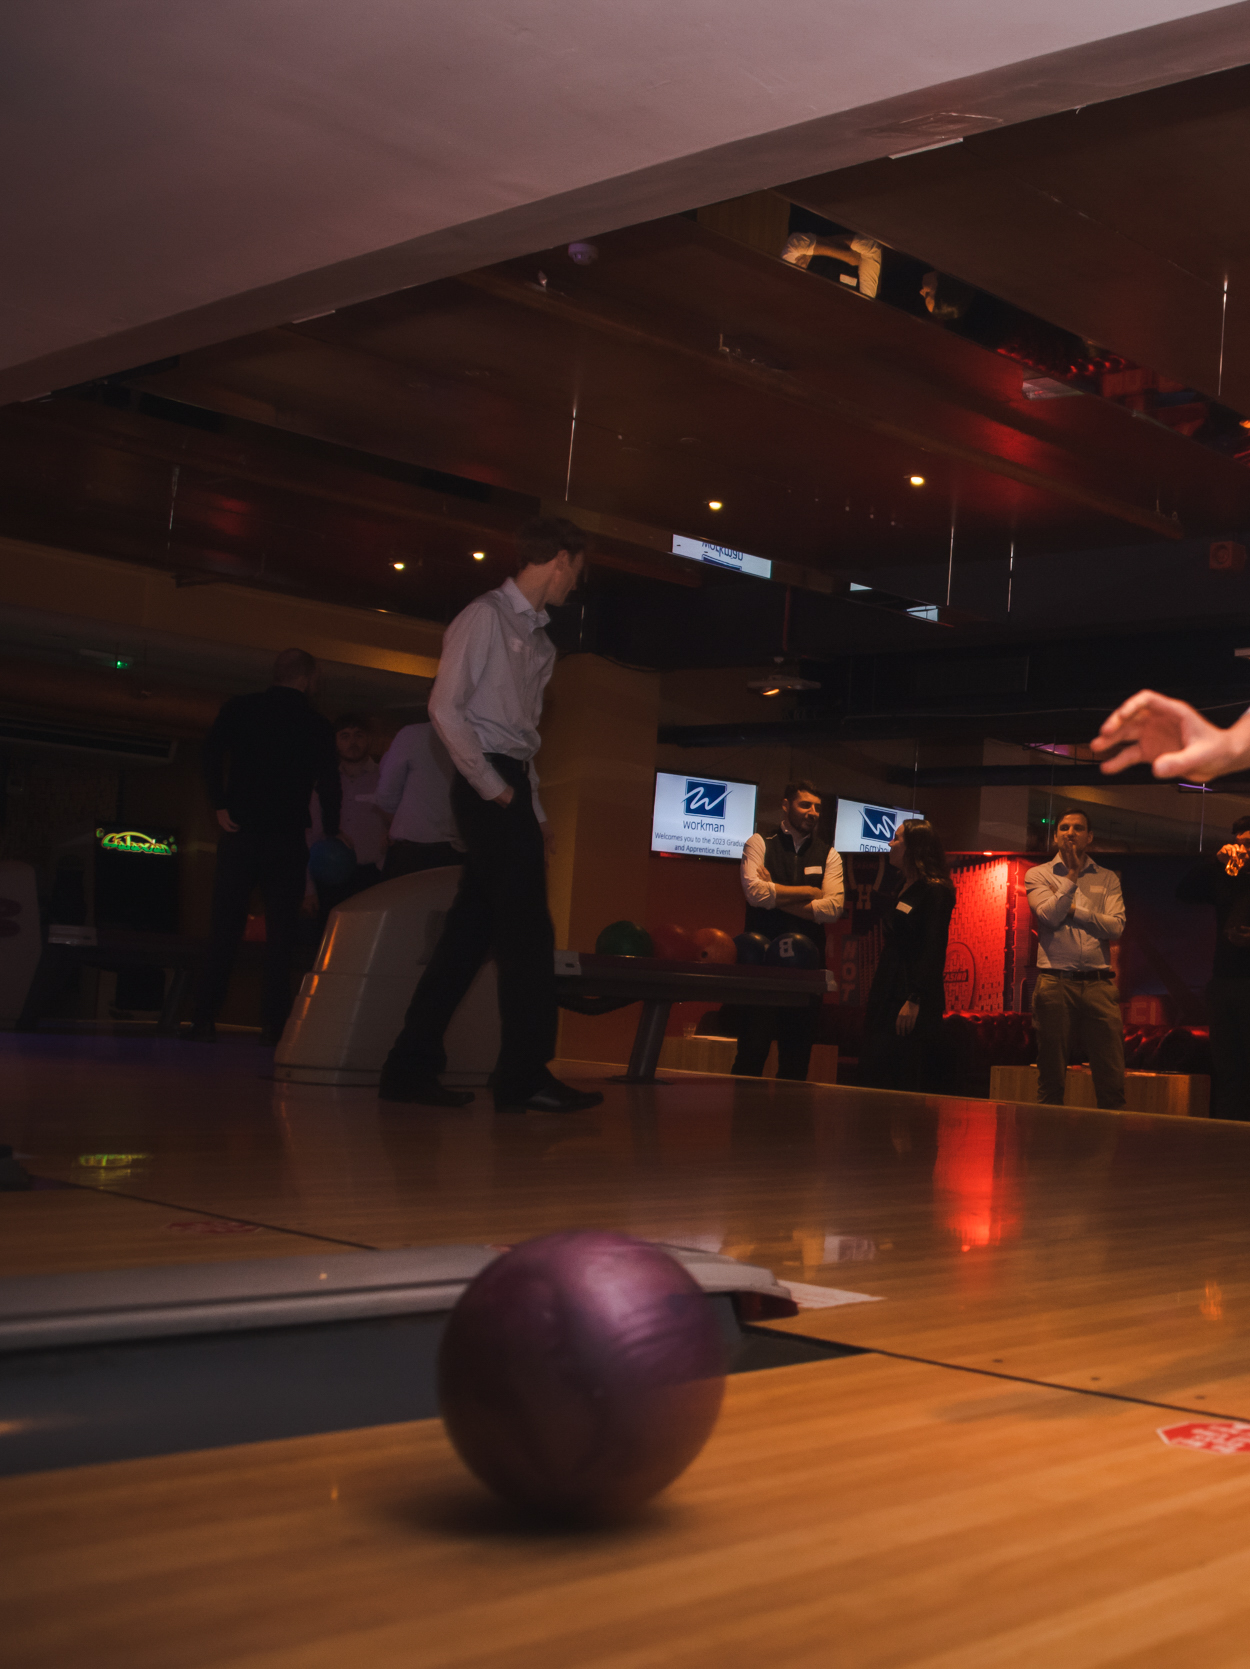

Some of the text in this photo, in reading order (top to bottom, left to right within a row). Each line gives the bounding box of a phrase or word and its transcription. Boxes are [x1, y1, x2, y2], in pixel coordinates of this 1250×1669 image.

[683, 819, 725, 833] workman
[655, 831, 745, 848] Welcomes you to the 2023 Gradua
[685, 845, 715, 855] Apprentice
[716, 847, 731, 855] Event
